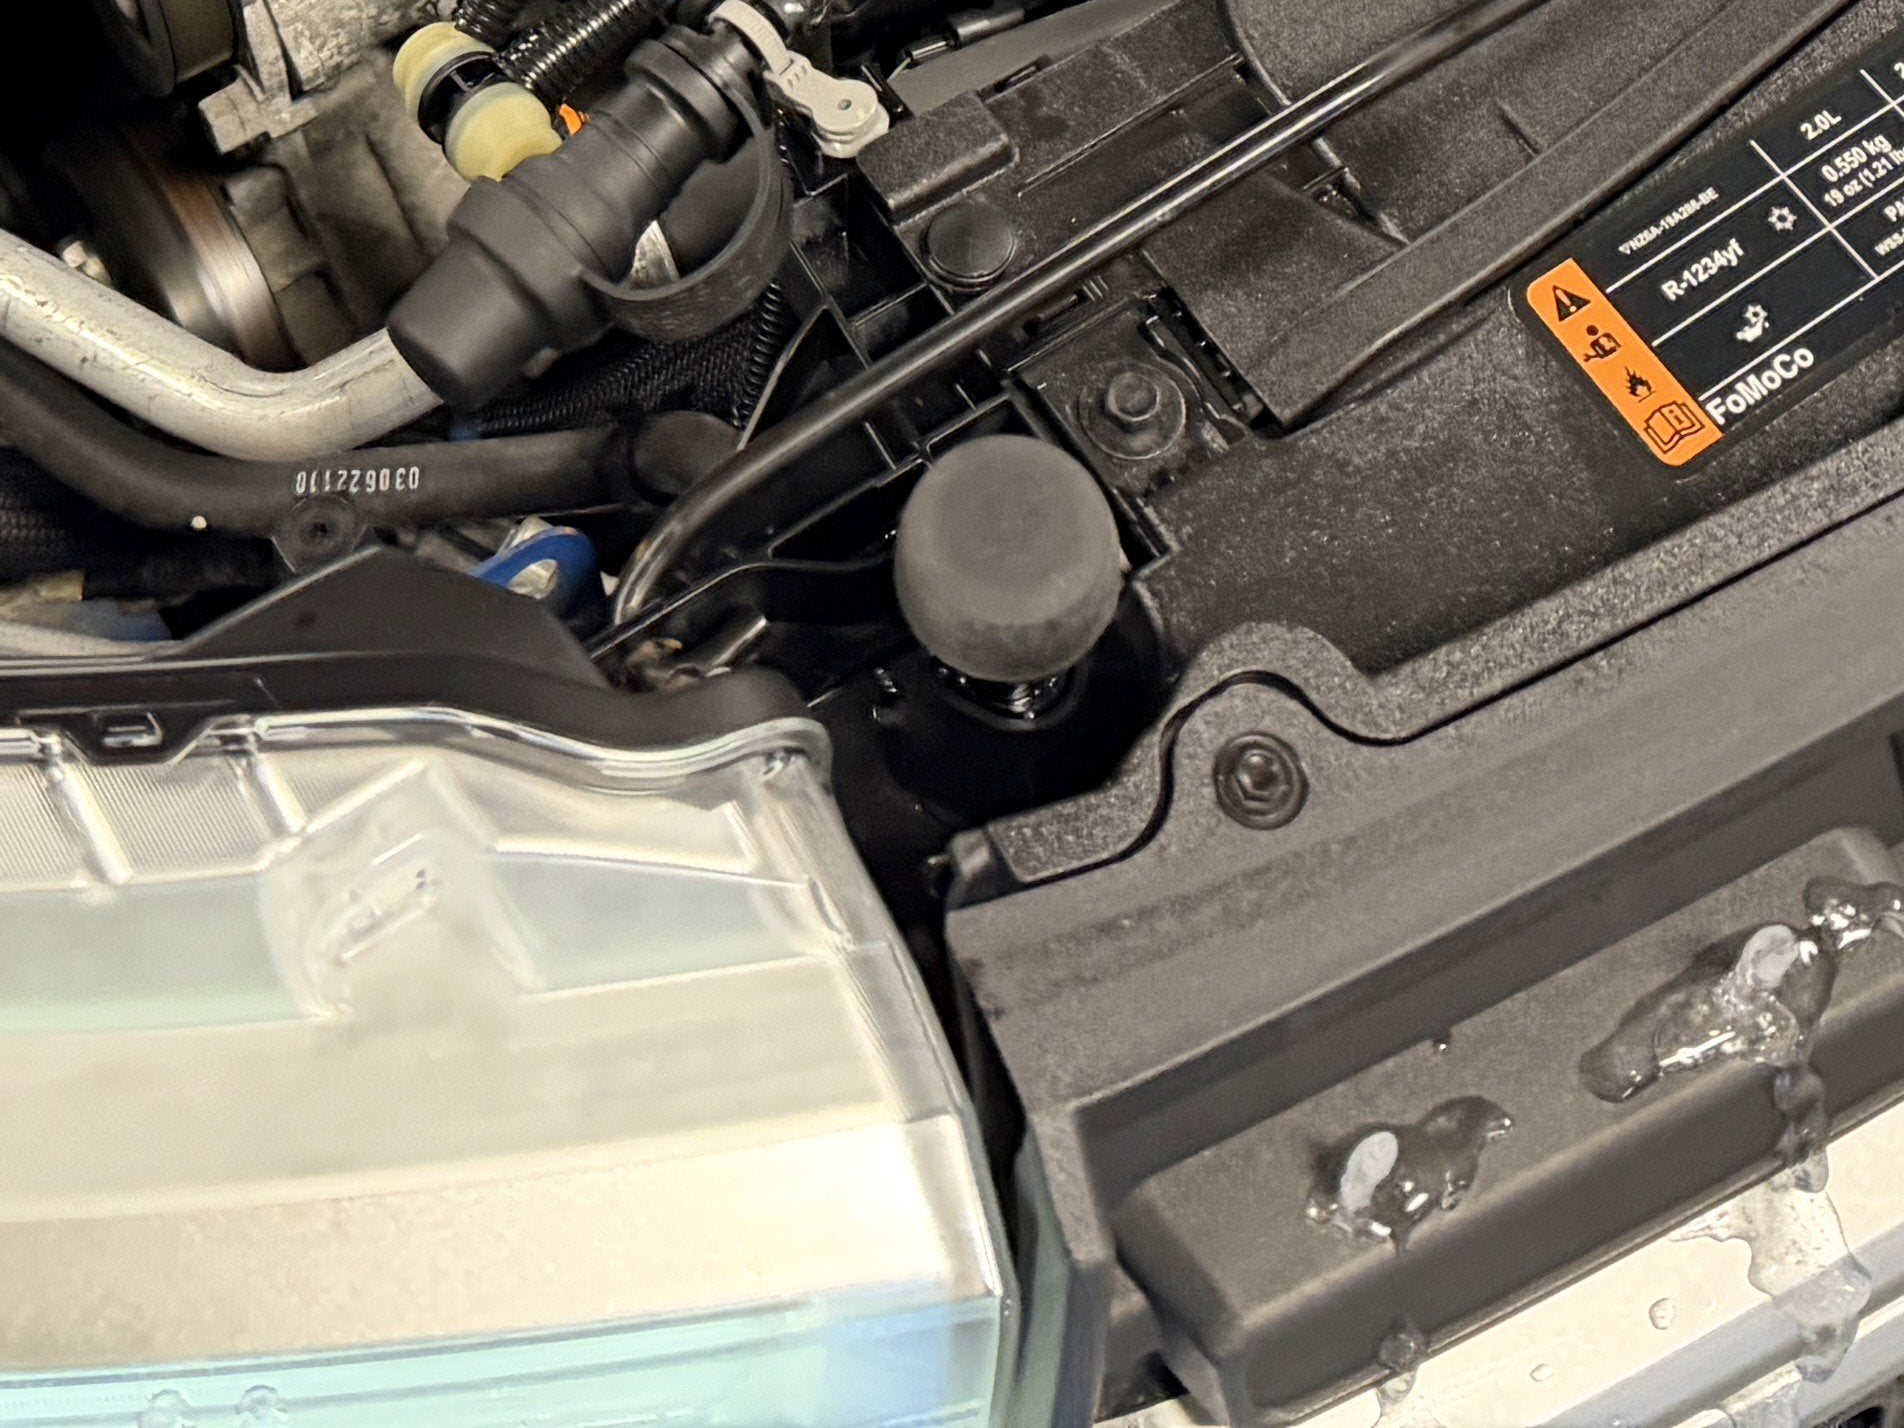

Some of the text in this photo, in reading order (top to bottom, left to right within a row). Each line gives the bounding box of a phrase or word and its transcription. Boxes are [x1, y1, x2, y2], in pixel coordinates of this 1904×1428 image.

[1799, 109, 1843, 141] 2.0L
[1821, 134, 1894, 183] 0.550 kg
[1824, 189, 1846, 208] 19
[1842, 179, 1864, 197] oz
[1859, 156, 1895, 189] (1.21
[1660, 238, 1745, 301] R-1234yf
[1705, 347, 1815, 426] FoMoCo
